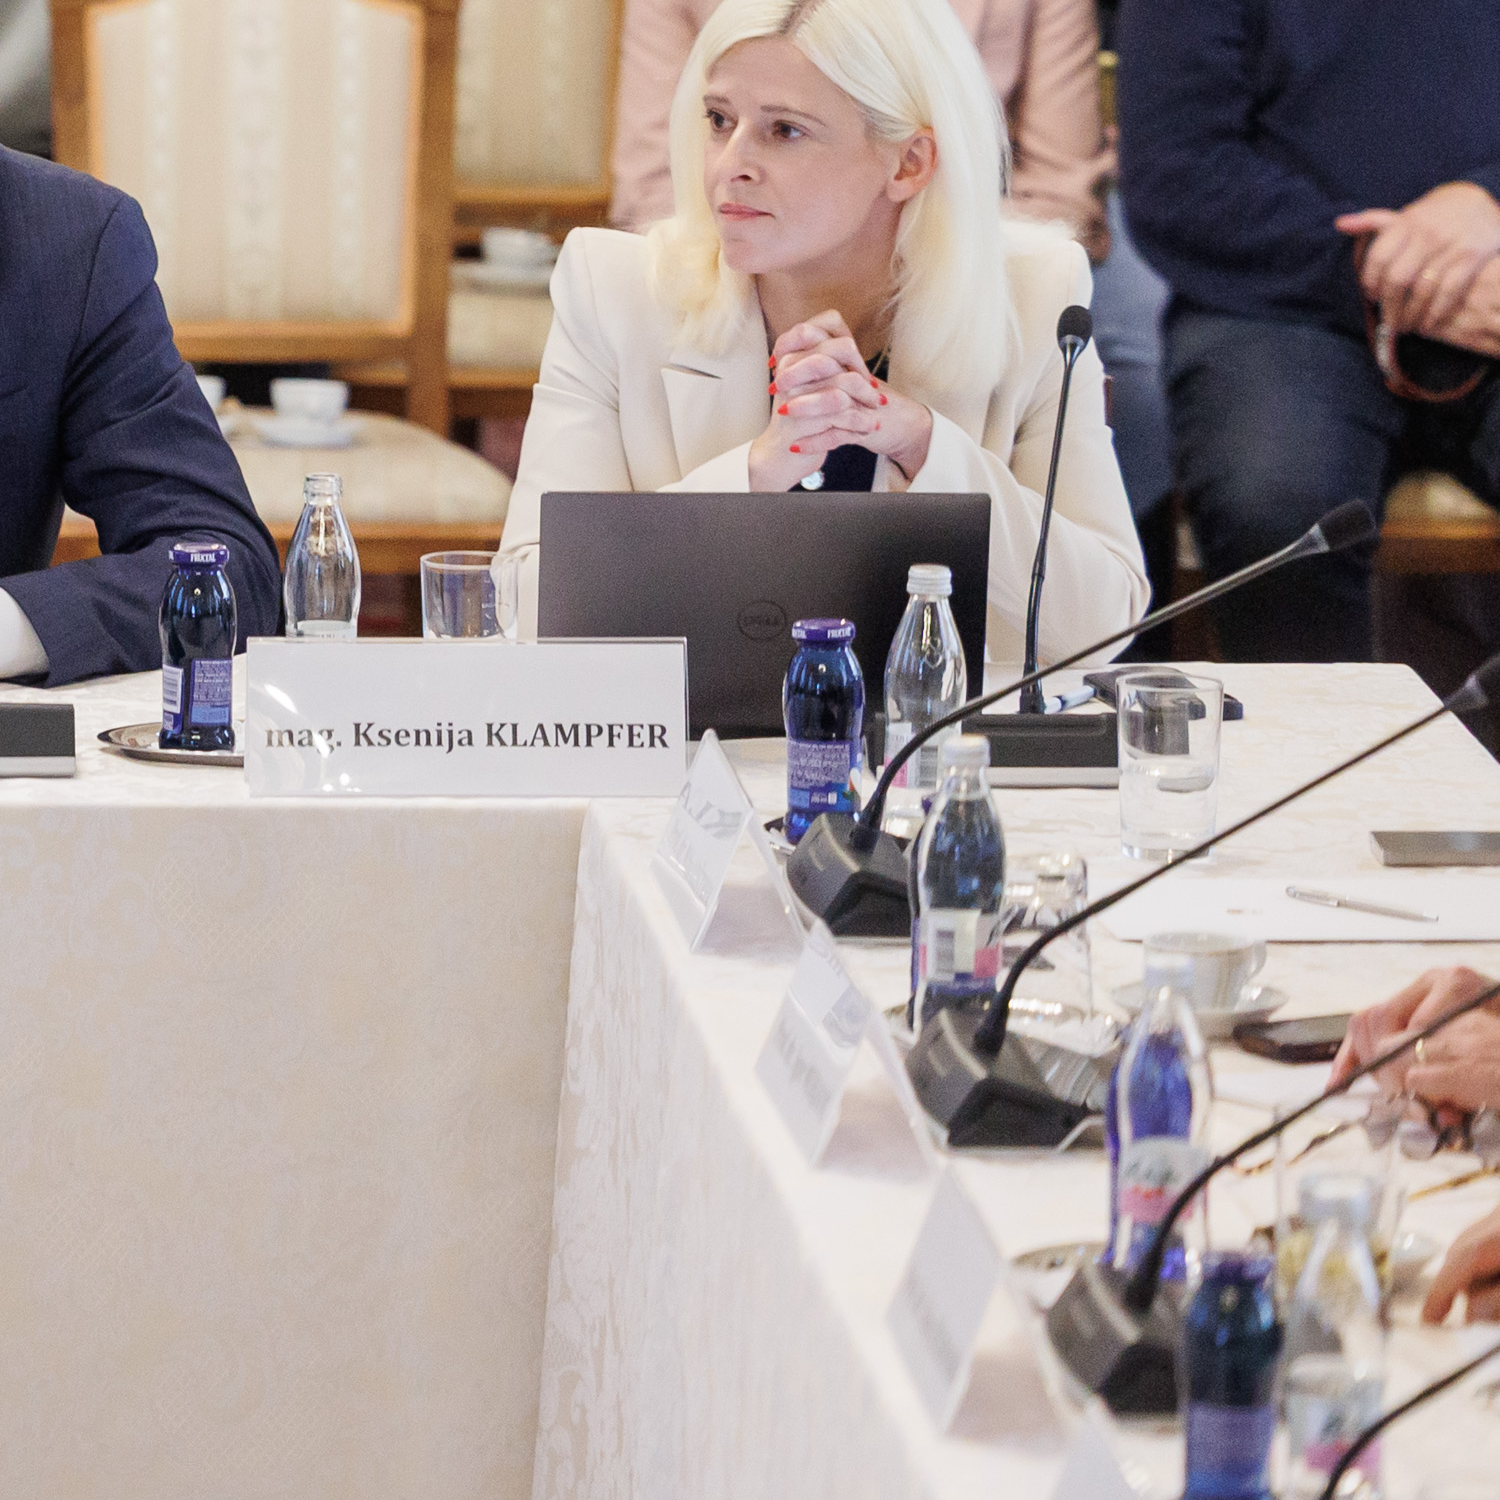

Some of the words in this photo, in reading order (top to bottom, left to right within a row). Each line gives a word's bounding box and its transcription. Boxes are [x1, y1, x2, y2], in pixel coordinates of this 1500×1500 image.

[264, 727, 342, 754] mag.
[352, 722, 475, 755] Ksenija
[485, 722, 670, 749] KLAMPFER
